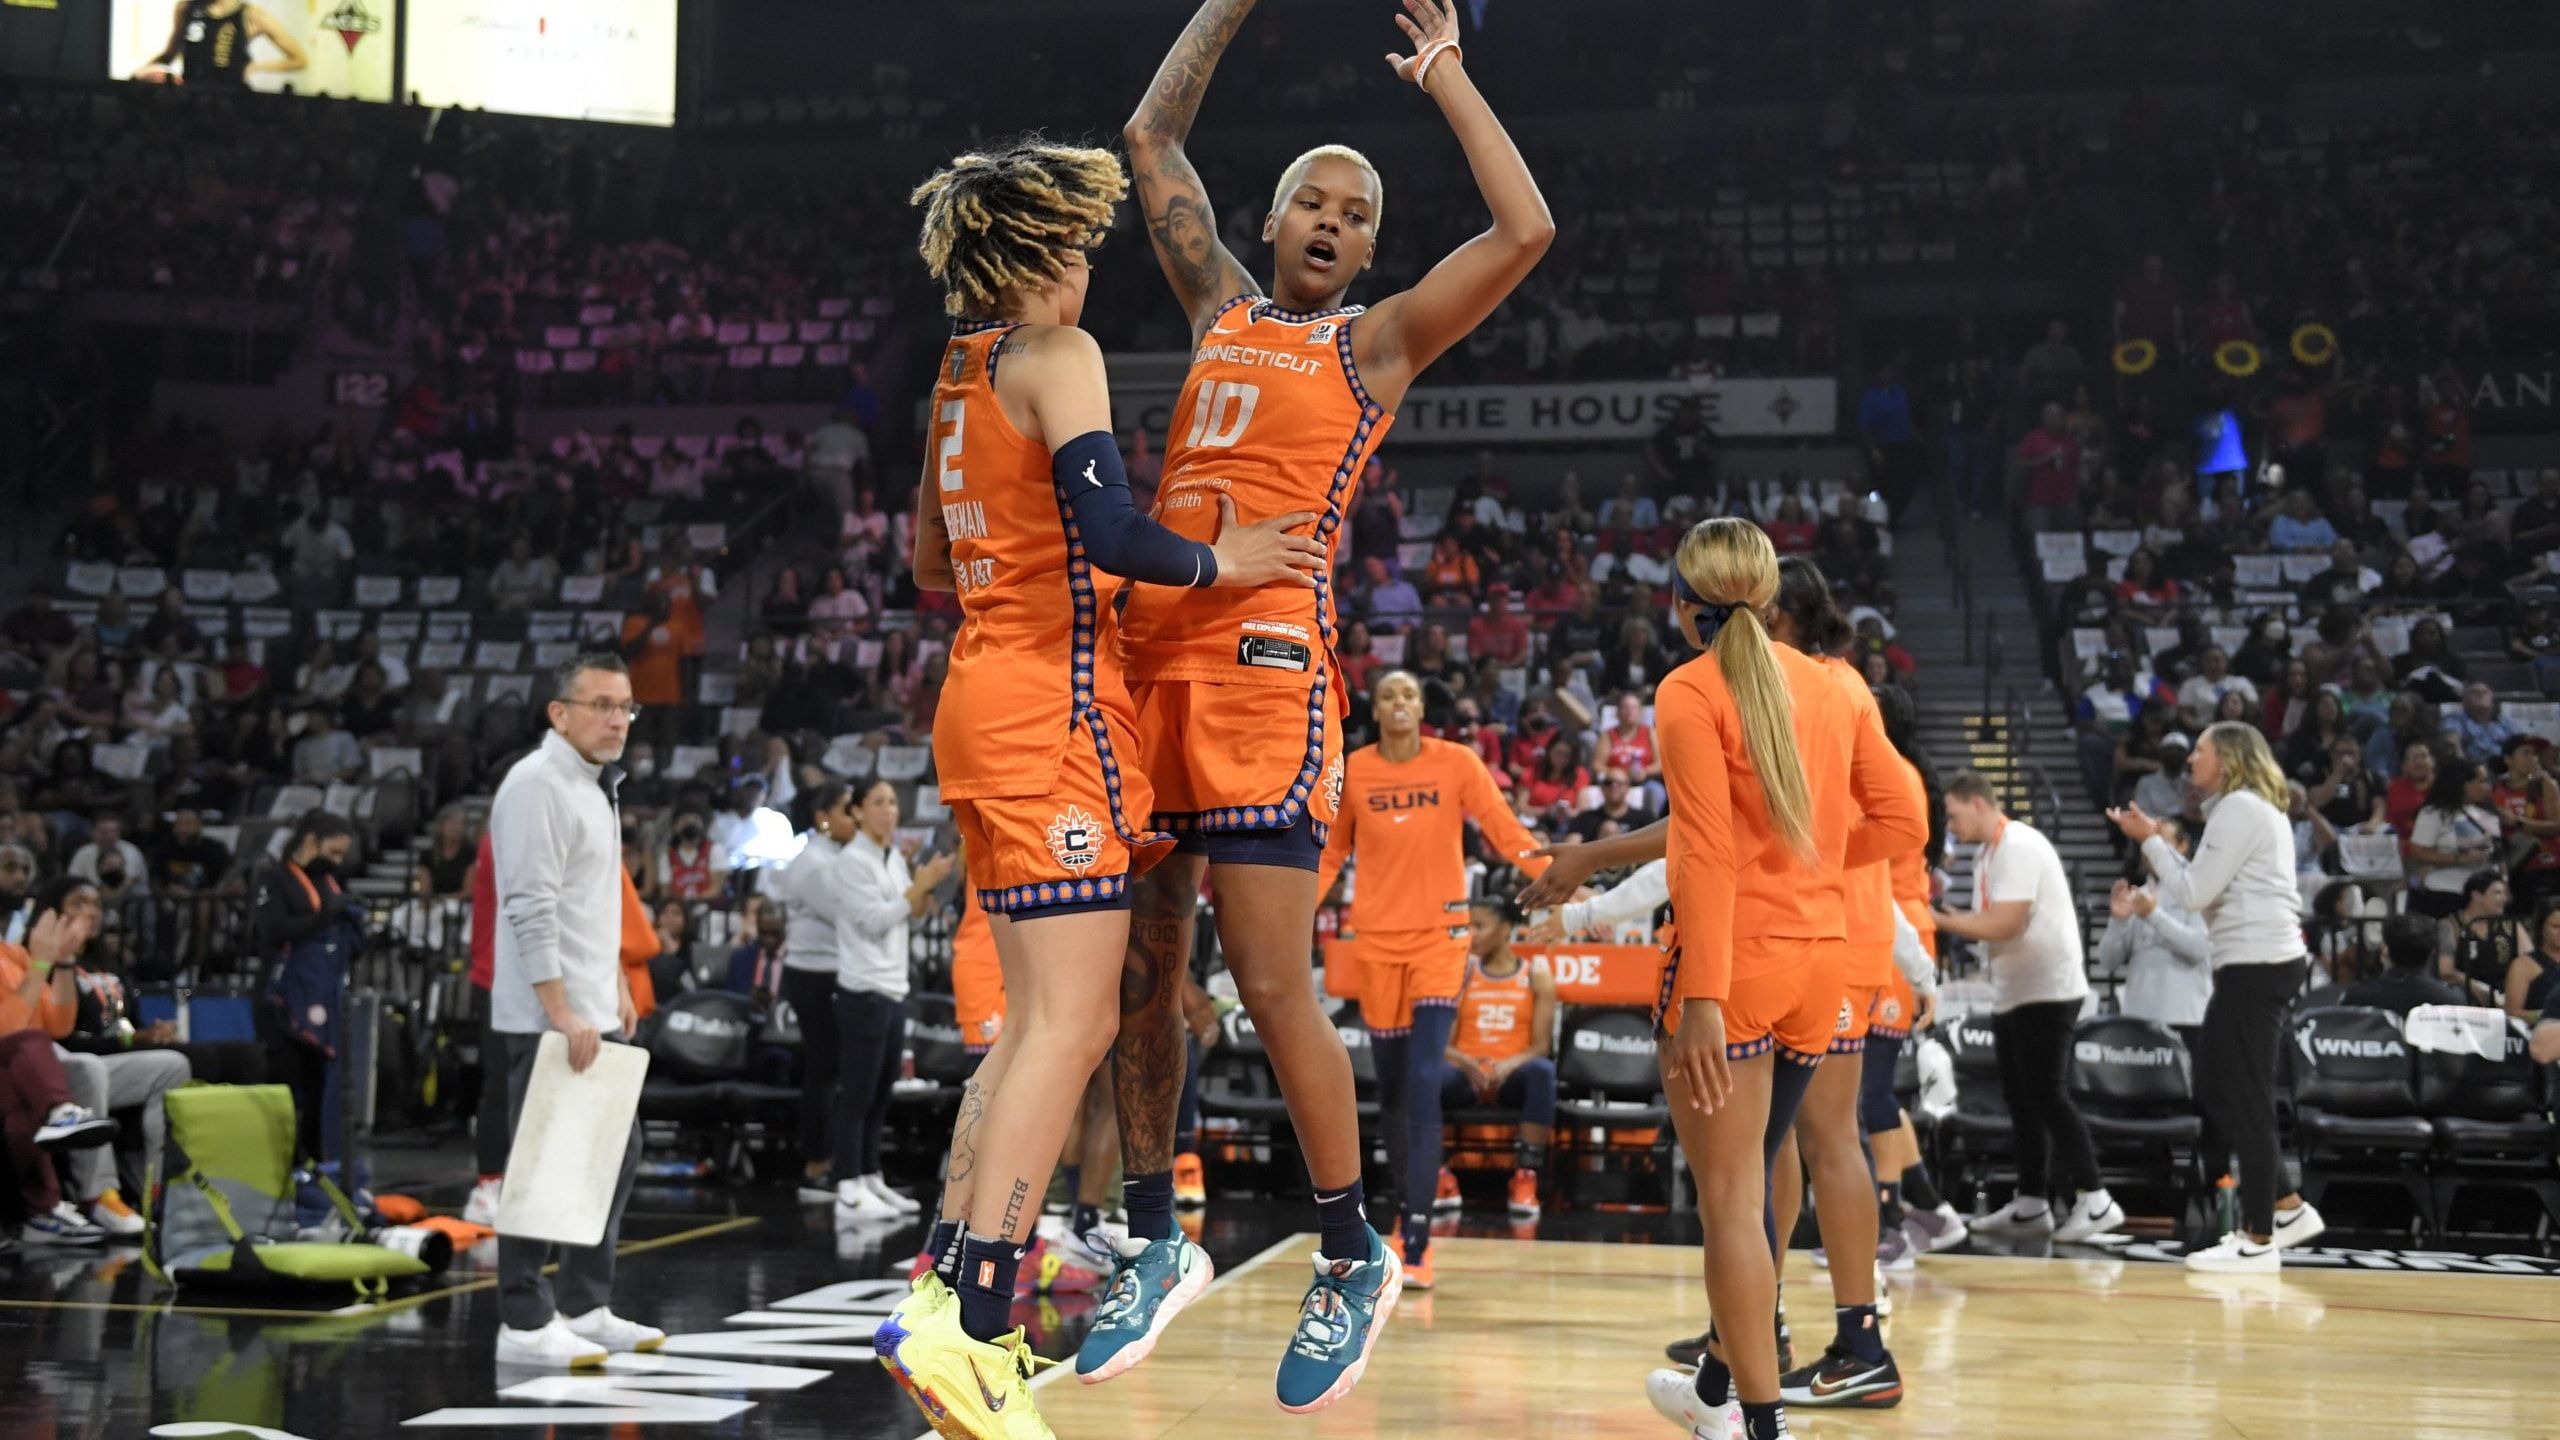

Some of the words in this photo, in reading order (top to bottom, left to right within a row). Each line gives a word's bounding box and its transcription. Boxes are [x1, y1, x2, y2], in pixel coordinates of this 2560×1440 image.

[1186, 379, 1260, 448] 10
[1405, 398, 1506, 430] THE
[1532, 392, 1722, 427] HOUSE
[940, 399, 965, 490] 2
[1367, 789, 1440, 813] SUN
[1477, 1003, 1516, 1032] 25
[2314, 1037, 2406, 1058] WNBA
[999, 1177, 1030, 1243] BELIEV
